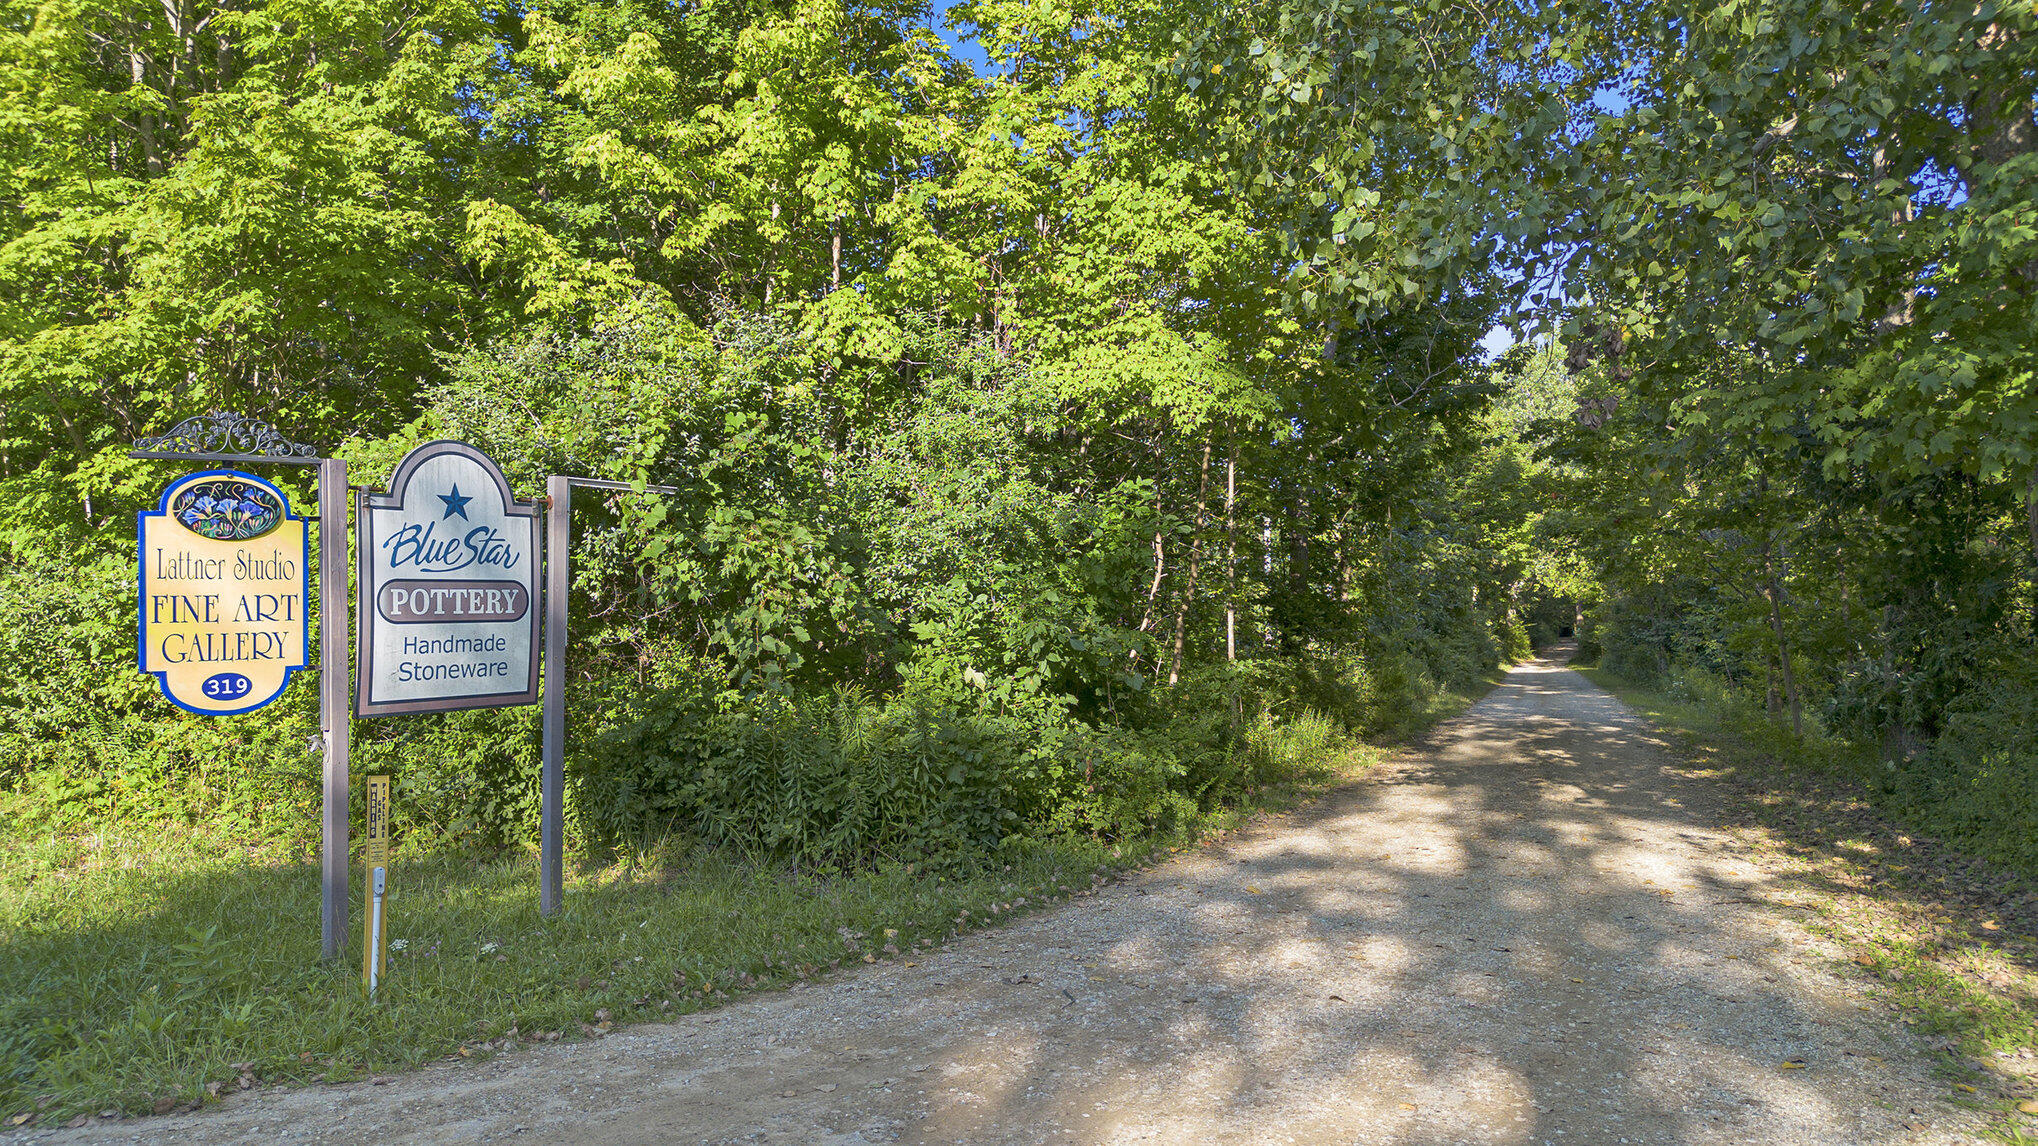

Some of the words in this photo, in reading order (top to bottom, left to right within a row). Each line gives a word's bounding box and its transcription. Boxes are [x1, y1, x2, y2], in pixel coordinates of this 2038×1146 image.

[382, 521, 463, 568] Blue
[420, 525, 520, 573] Star
[156, 548, 226, 580] Lattner
[233, 548, 295, 580] Studio
[151, 594, 220, 624] FINE
[232, 594, 299, 623] ART
[390, 588, 519, 615] POTTERY
[161, 631, 289, 663] GALLERY
[403, 634, 506, 655] Handmade
[207, 678, 248, 695] 319
[398, 661, 508, 682] Stoneware
